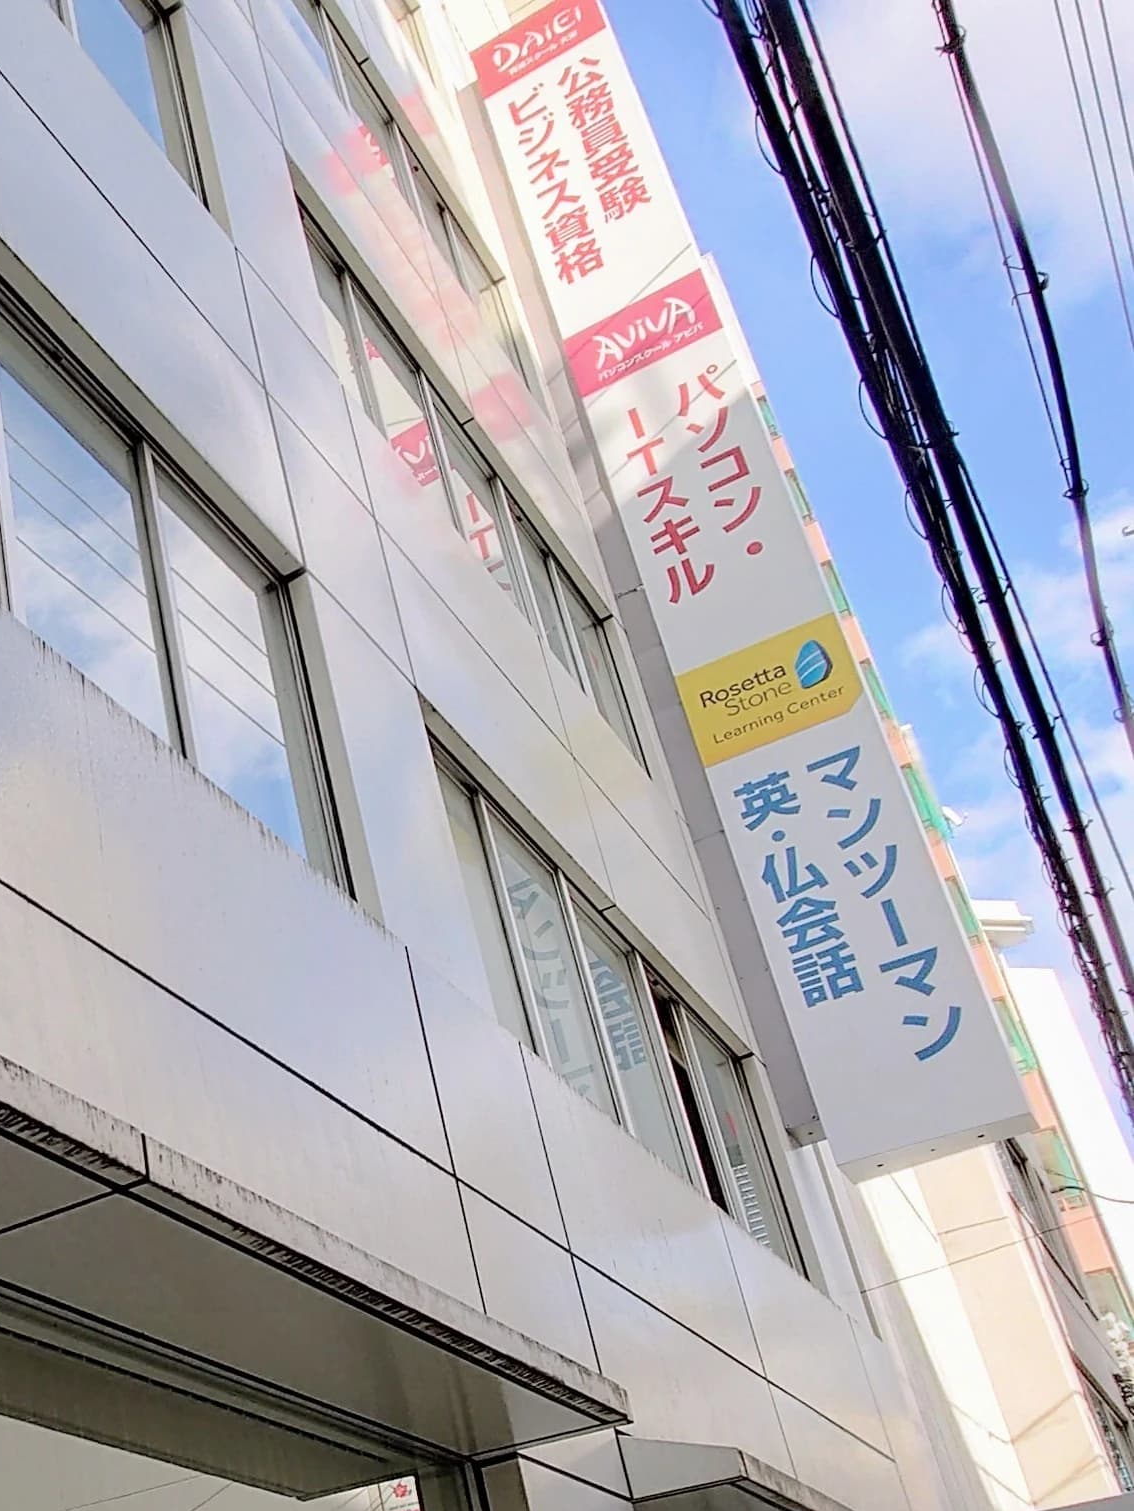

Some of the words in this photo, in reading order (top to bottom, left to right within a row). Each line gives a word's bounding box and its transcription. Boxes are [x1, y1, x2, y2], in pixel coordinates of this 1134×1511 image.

[508, 83, 604, 285] ビジネス資格
[557, 55, 652, 224] 公務員受験
[699, 662, 786, 709] Rosetta
[712, 706, 785, 746] Learning
[786, 684, 845, 726] Center
[725, 679, 792, 719] Stone
[733, 771, 865, 1009] 英・仏会話
[806, 745, 961, 1062] マンツーマン
